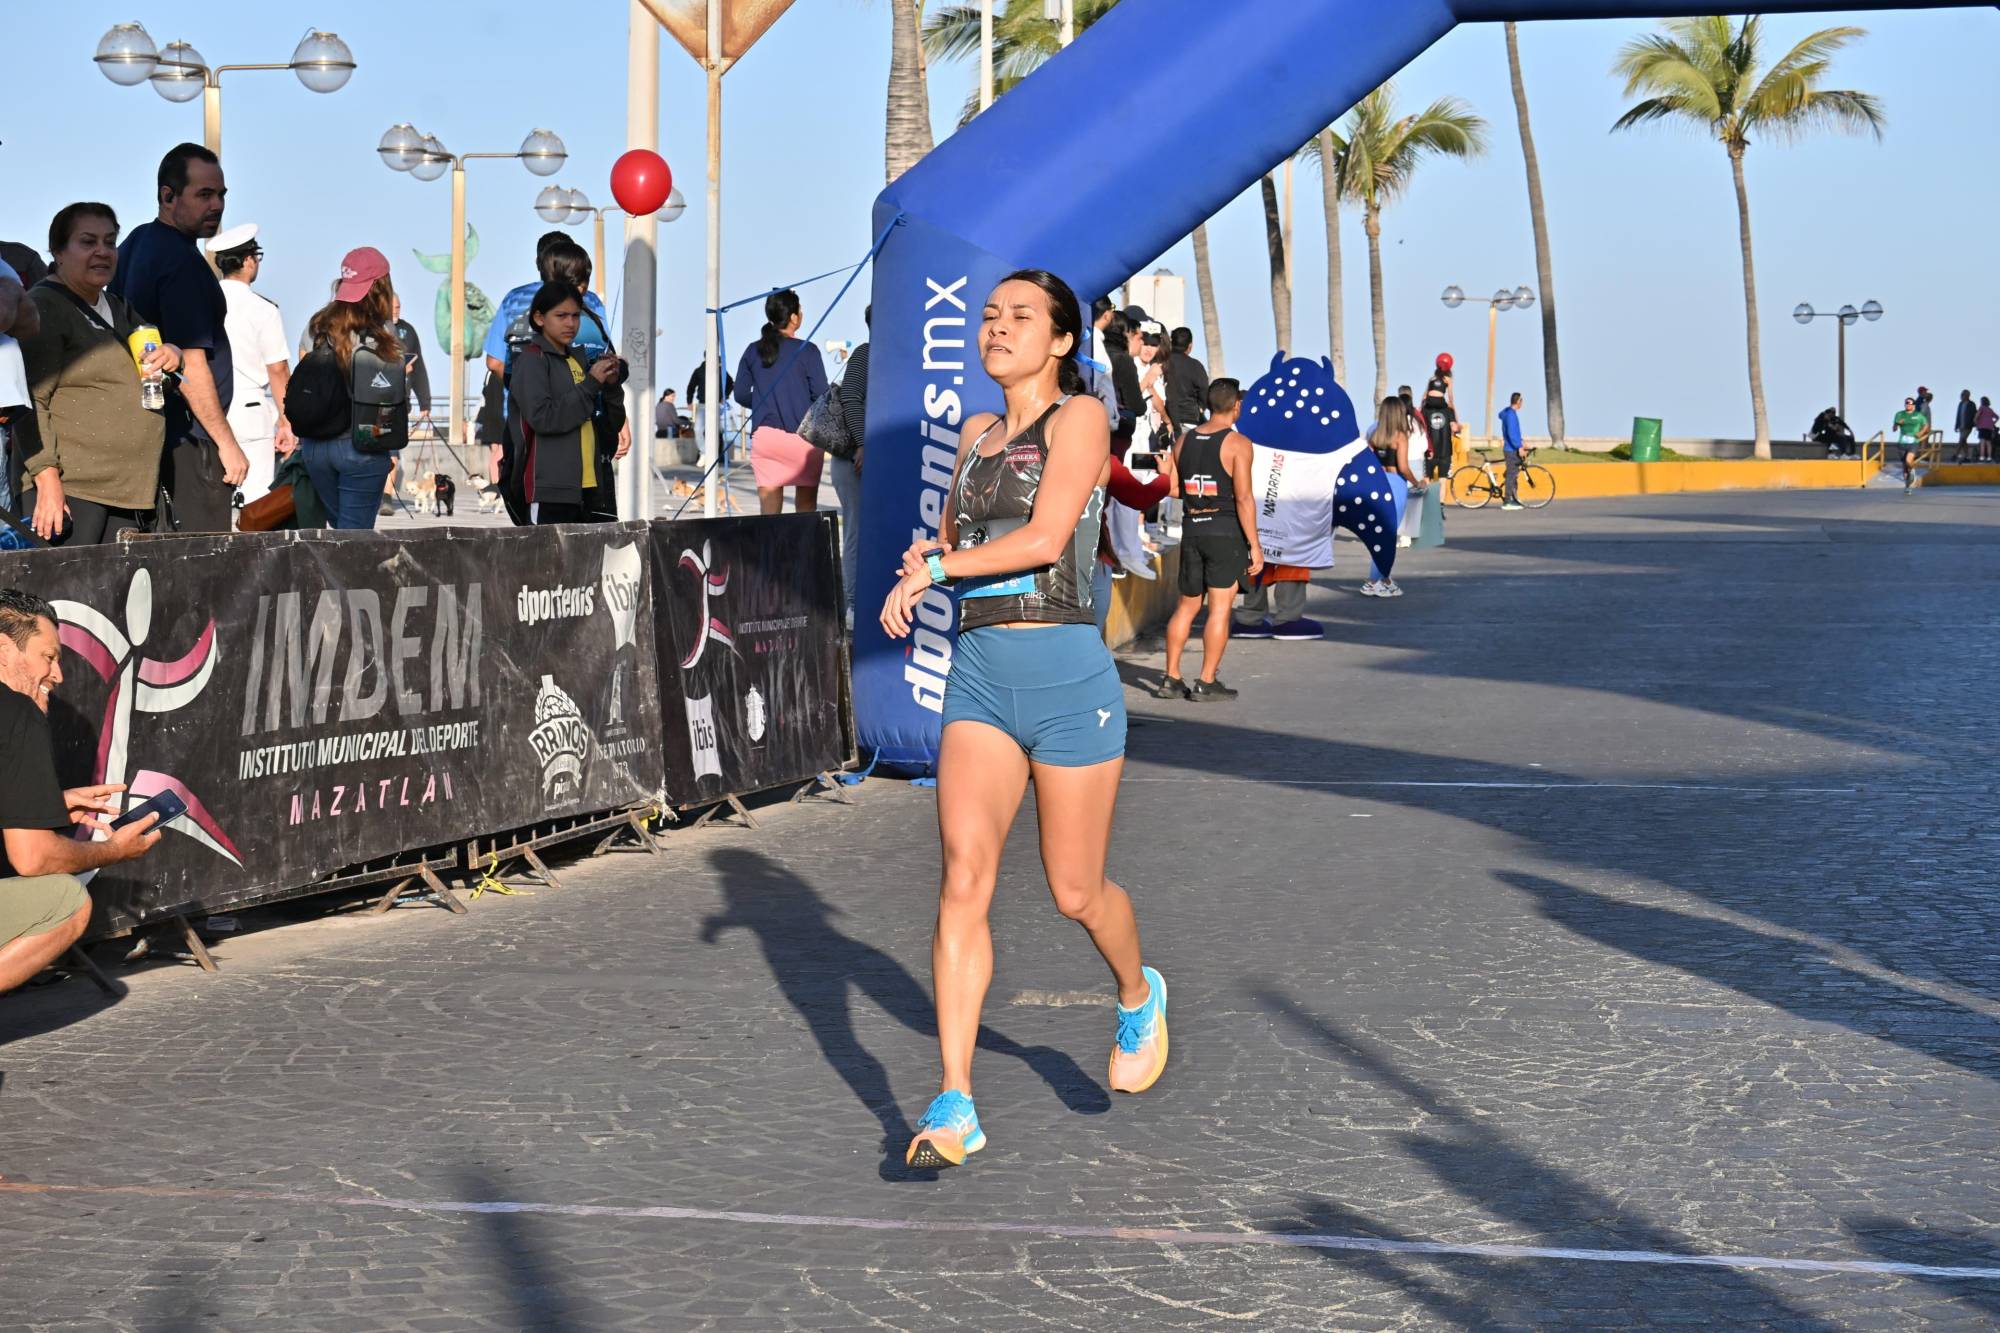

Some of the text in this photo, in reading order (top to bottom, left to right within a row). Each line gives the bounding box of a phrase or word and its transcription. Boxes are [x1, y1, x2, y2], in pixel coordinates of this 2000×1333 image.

[517, 584, 595, 626] dportenis
[241, 583, 482, 736] IMDEM
[238, 720, 479, 781] INSTITUTO MUNICIPAL DEL DEPORTE
[691, 718, 714, 751] ibis
